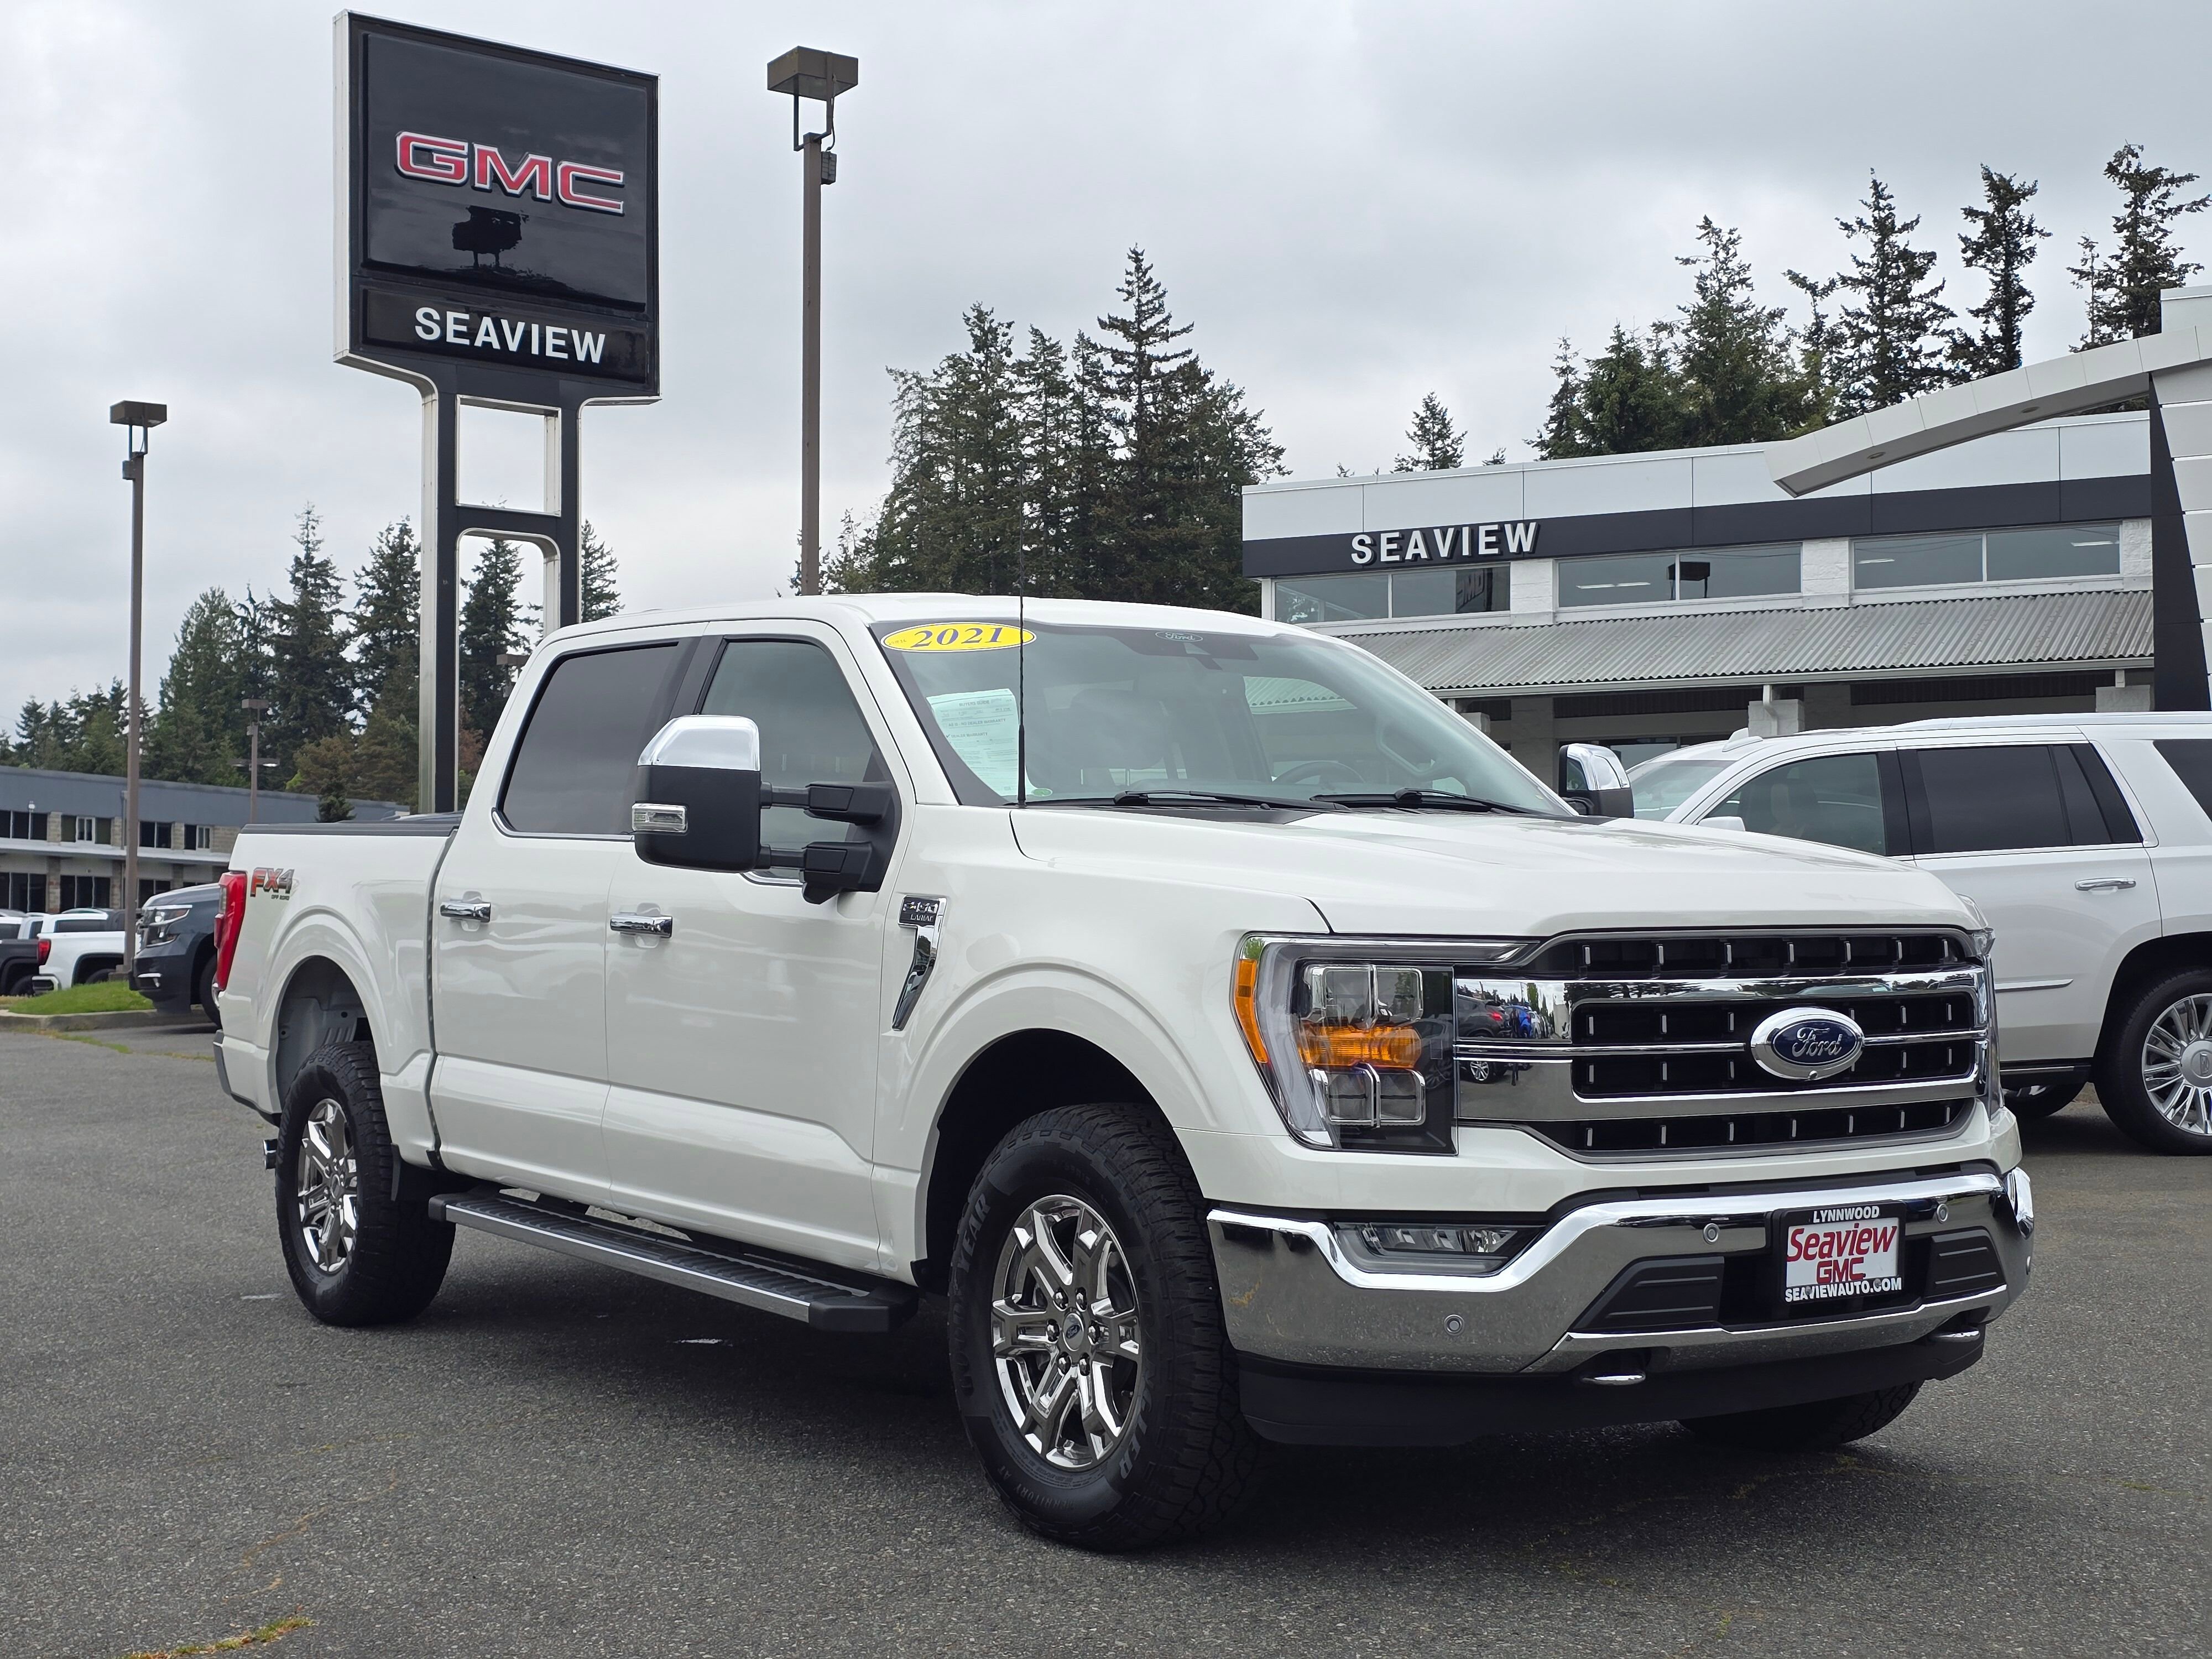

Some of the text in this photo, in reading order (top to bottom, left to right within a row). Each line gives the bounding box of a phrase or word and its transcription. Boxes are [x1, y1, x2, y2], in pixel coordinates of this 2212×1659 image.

[395, 131, 624, 215] GMC
[415, 307, 606, 363] SEAVIEW
[1351, 521, 1539, 564] SEAVIEW
[910, 627, 1004, 648] 2021
[1165, 632, 1196, 640] Ford
[250, 867, 295, 898] FX4
[1792, 1027, 1843, 1057] Ford
[1813, 1206, 1880, 1223] LYNNWOOD
[1787, 1223, 1898, 1262] Seaview
[1816, 1256, 1865, 1284] GMC
